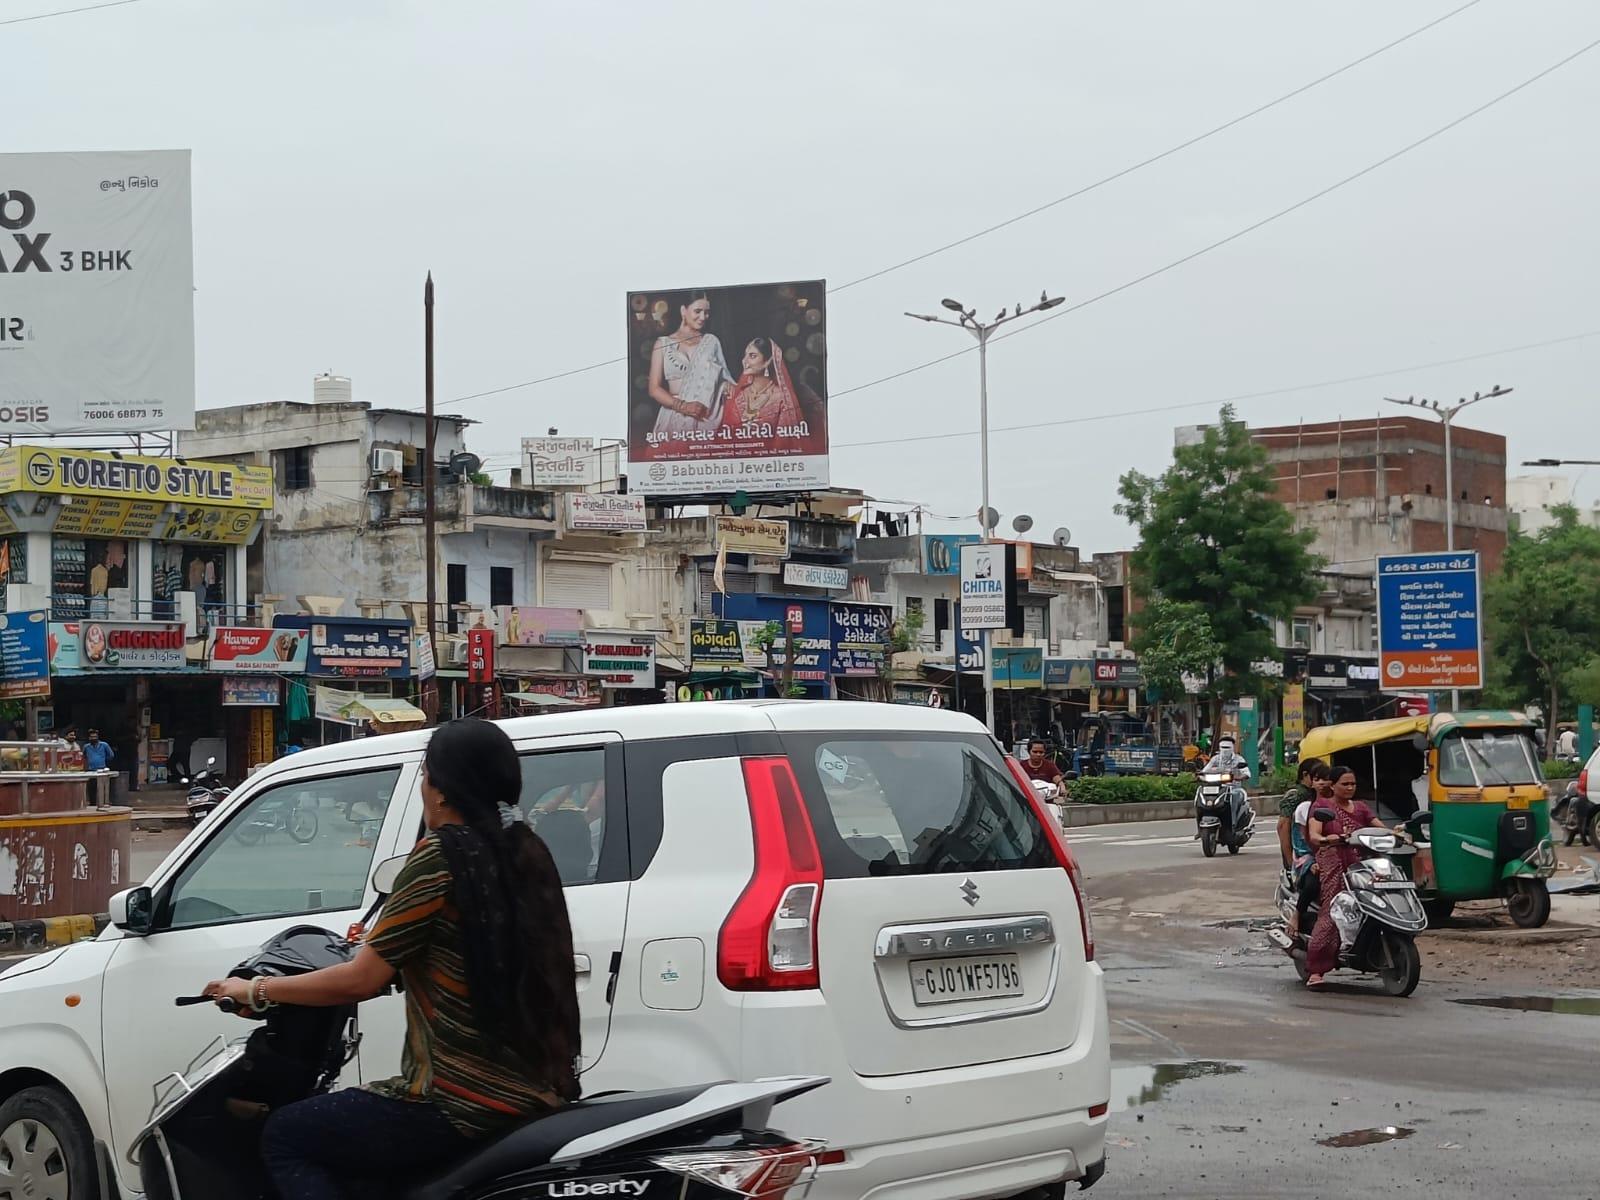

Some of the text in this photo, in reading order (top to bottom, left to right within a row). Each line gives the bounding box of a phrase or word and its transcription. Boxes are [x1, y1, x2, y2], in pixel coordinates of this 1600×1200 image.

[128, 175, 159, 188] નિકોલ
[60, 251, 74, 272] 3
[81, 250, 133, 271] BHK
[84, 410, 114, 419] 76006
[117, 409, 147, 418] 68873
[646, 431, 669, 448] શુભ
[672, 429, 715, 442] અવસર
[776, 420, 810, 440] સાક્ષી
[535, 439, 580, 453] સંજીવની
[32, 463, 54, 477] TS
[671, 460, 805, 477] Babubhai Jewellers
[59, 456, 161, 491] TORETTO
[167, 468, 233, 497] STYLE
[1420, 561, 1446, 570] નગર
[1448, 558, 1470, 569] વોર્ડ
[963, 580, 1003, 594] CHITRA
[788, 610, 803, 623] CB
[834, 606, 887, 628] પટેલ મંડપ
[223, 630, 261, 645] Havmor
[692, 630, 737, 647] ભગવતી
[1098, 666, 1117, 678] GM
[925, 962, 1019, 995] GJ01WF5796
[548, 1178, 651, 1198] Liberty
